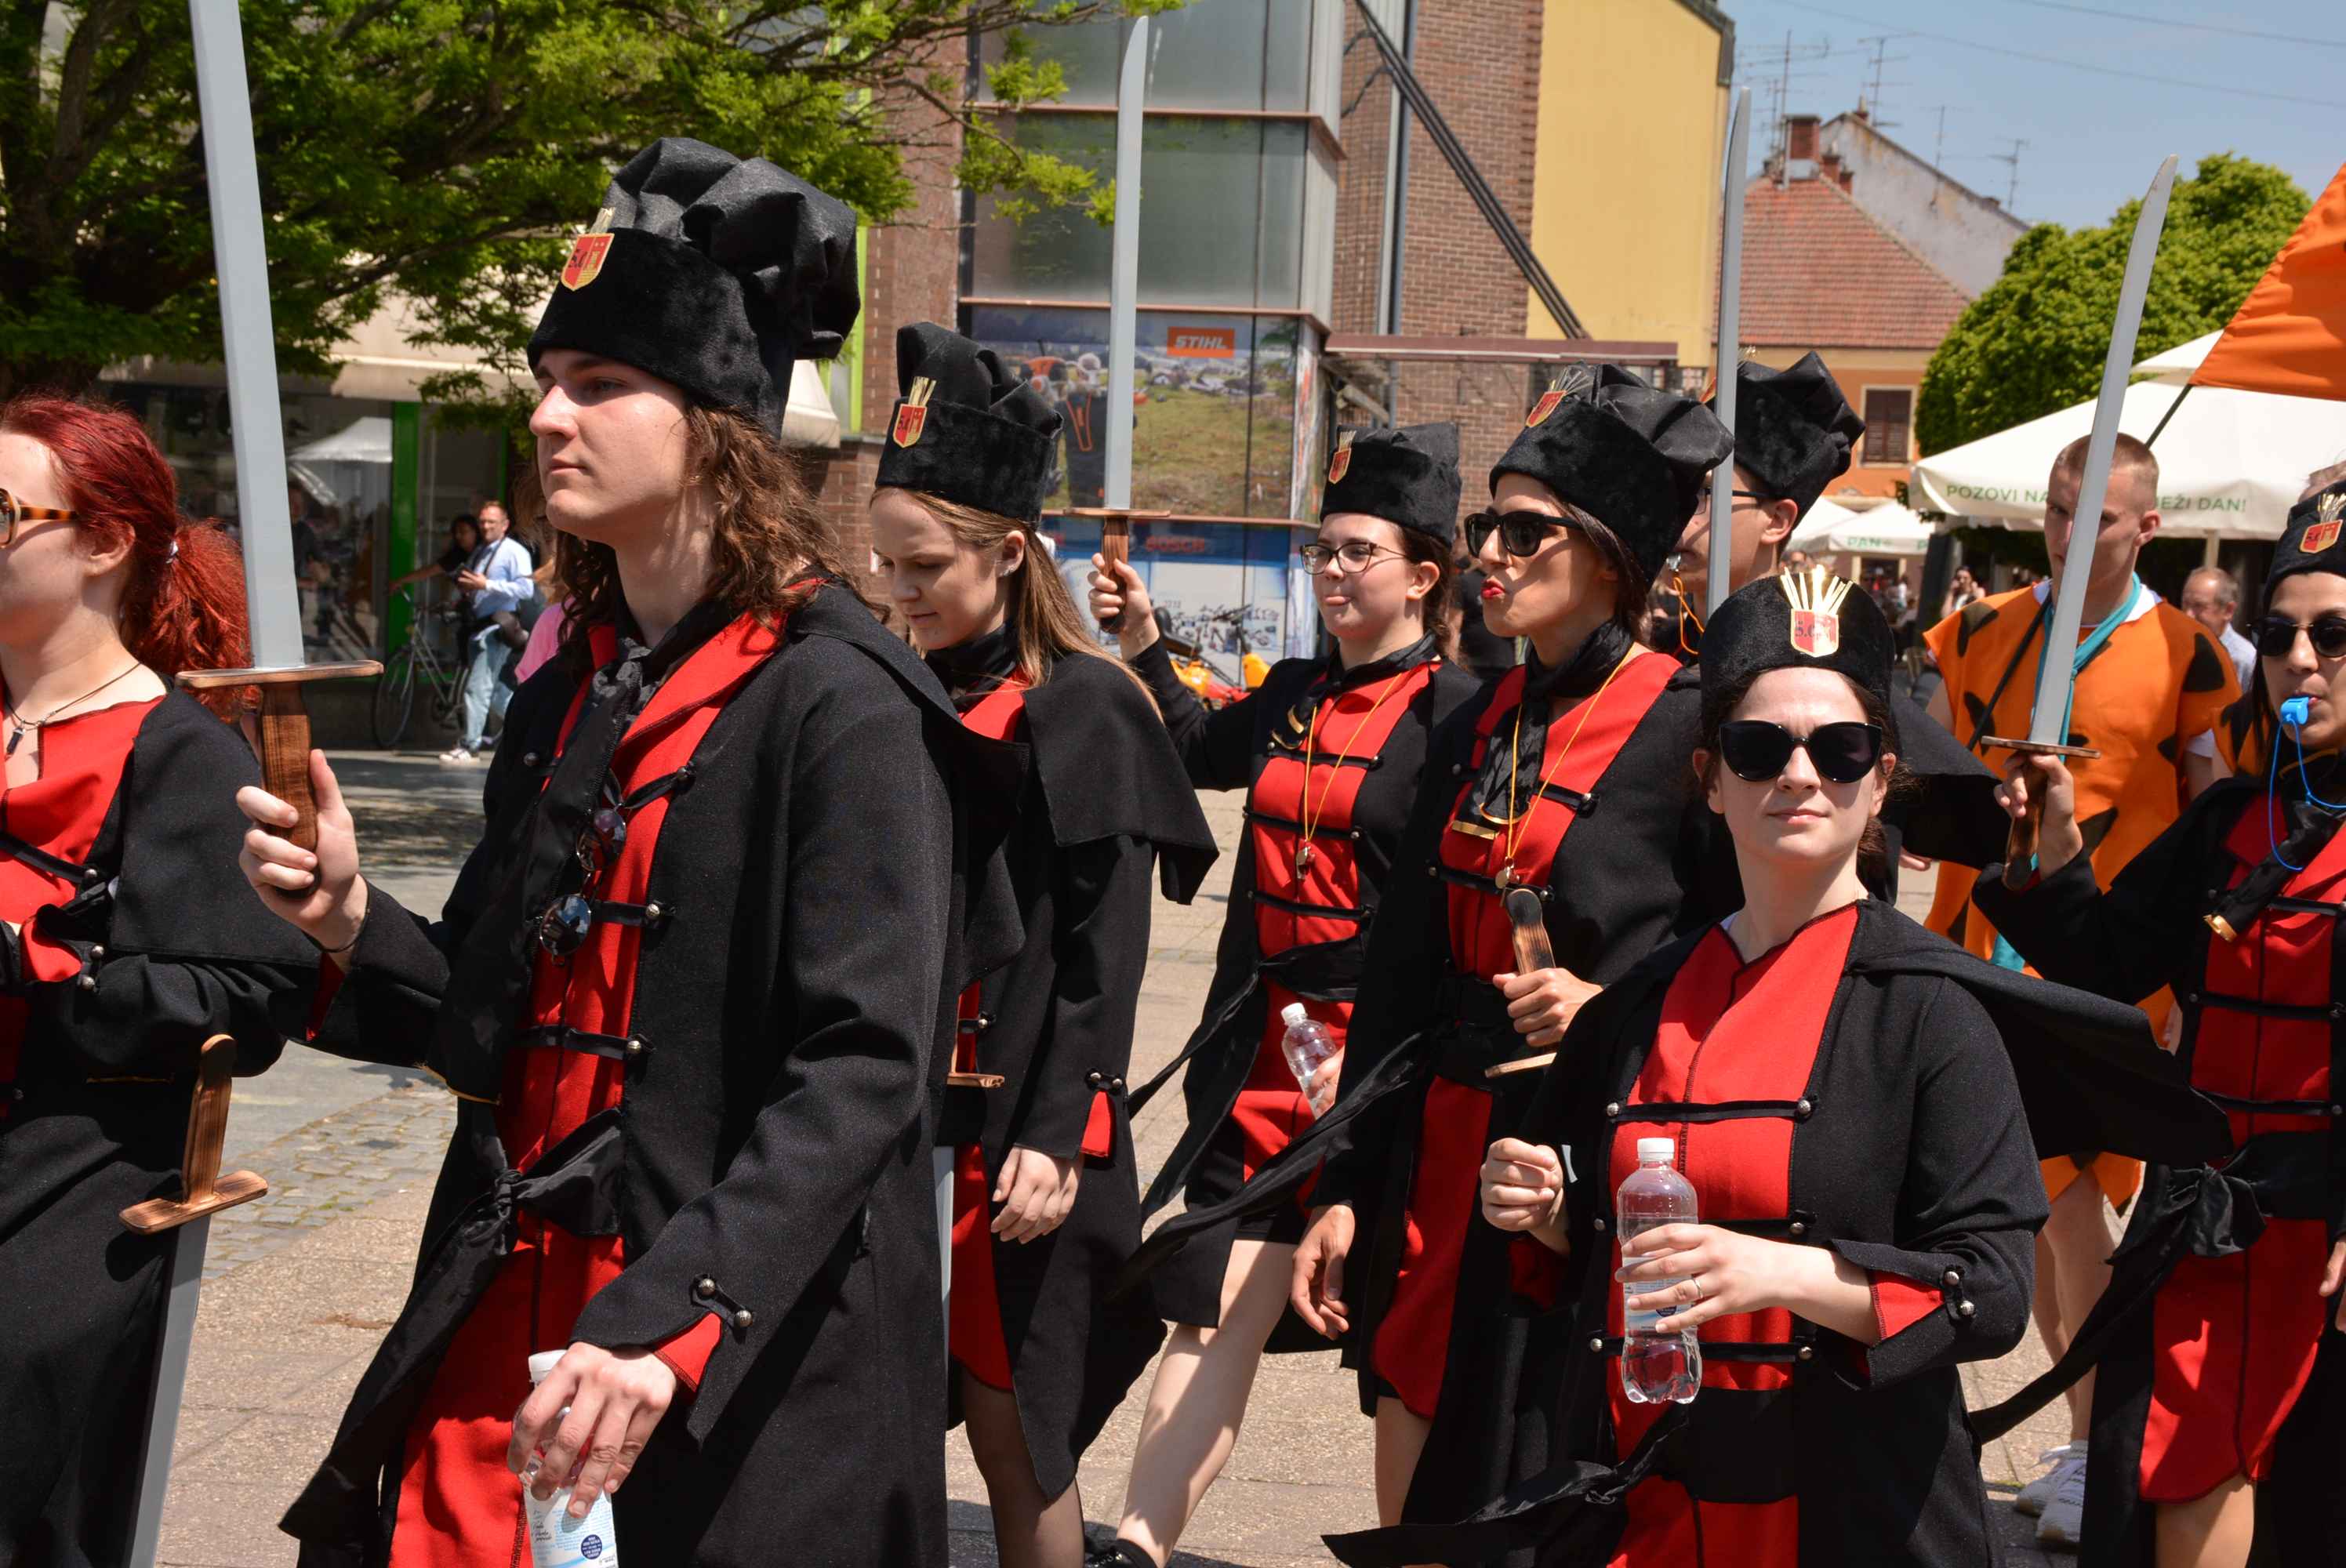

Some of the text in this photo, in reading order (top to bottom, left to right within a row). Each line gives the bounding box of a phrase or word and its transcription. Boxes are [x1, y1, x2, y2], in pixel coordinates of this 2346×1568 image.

[1175, 336, 1229, 350] STIHL
[1946, 485, 2017, 502] POZOVI
[2197, 496, 2246, 512] DAN!
